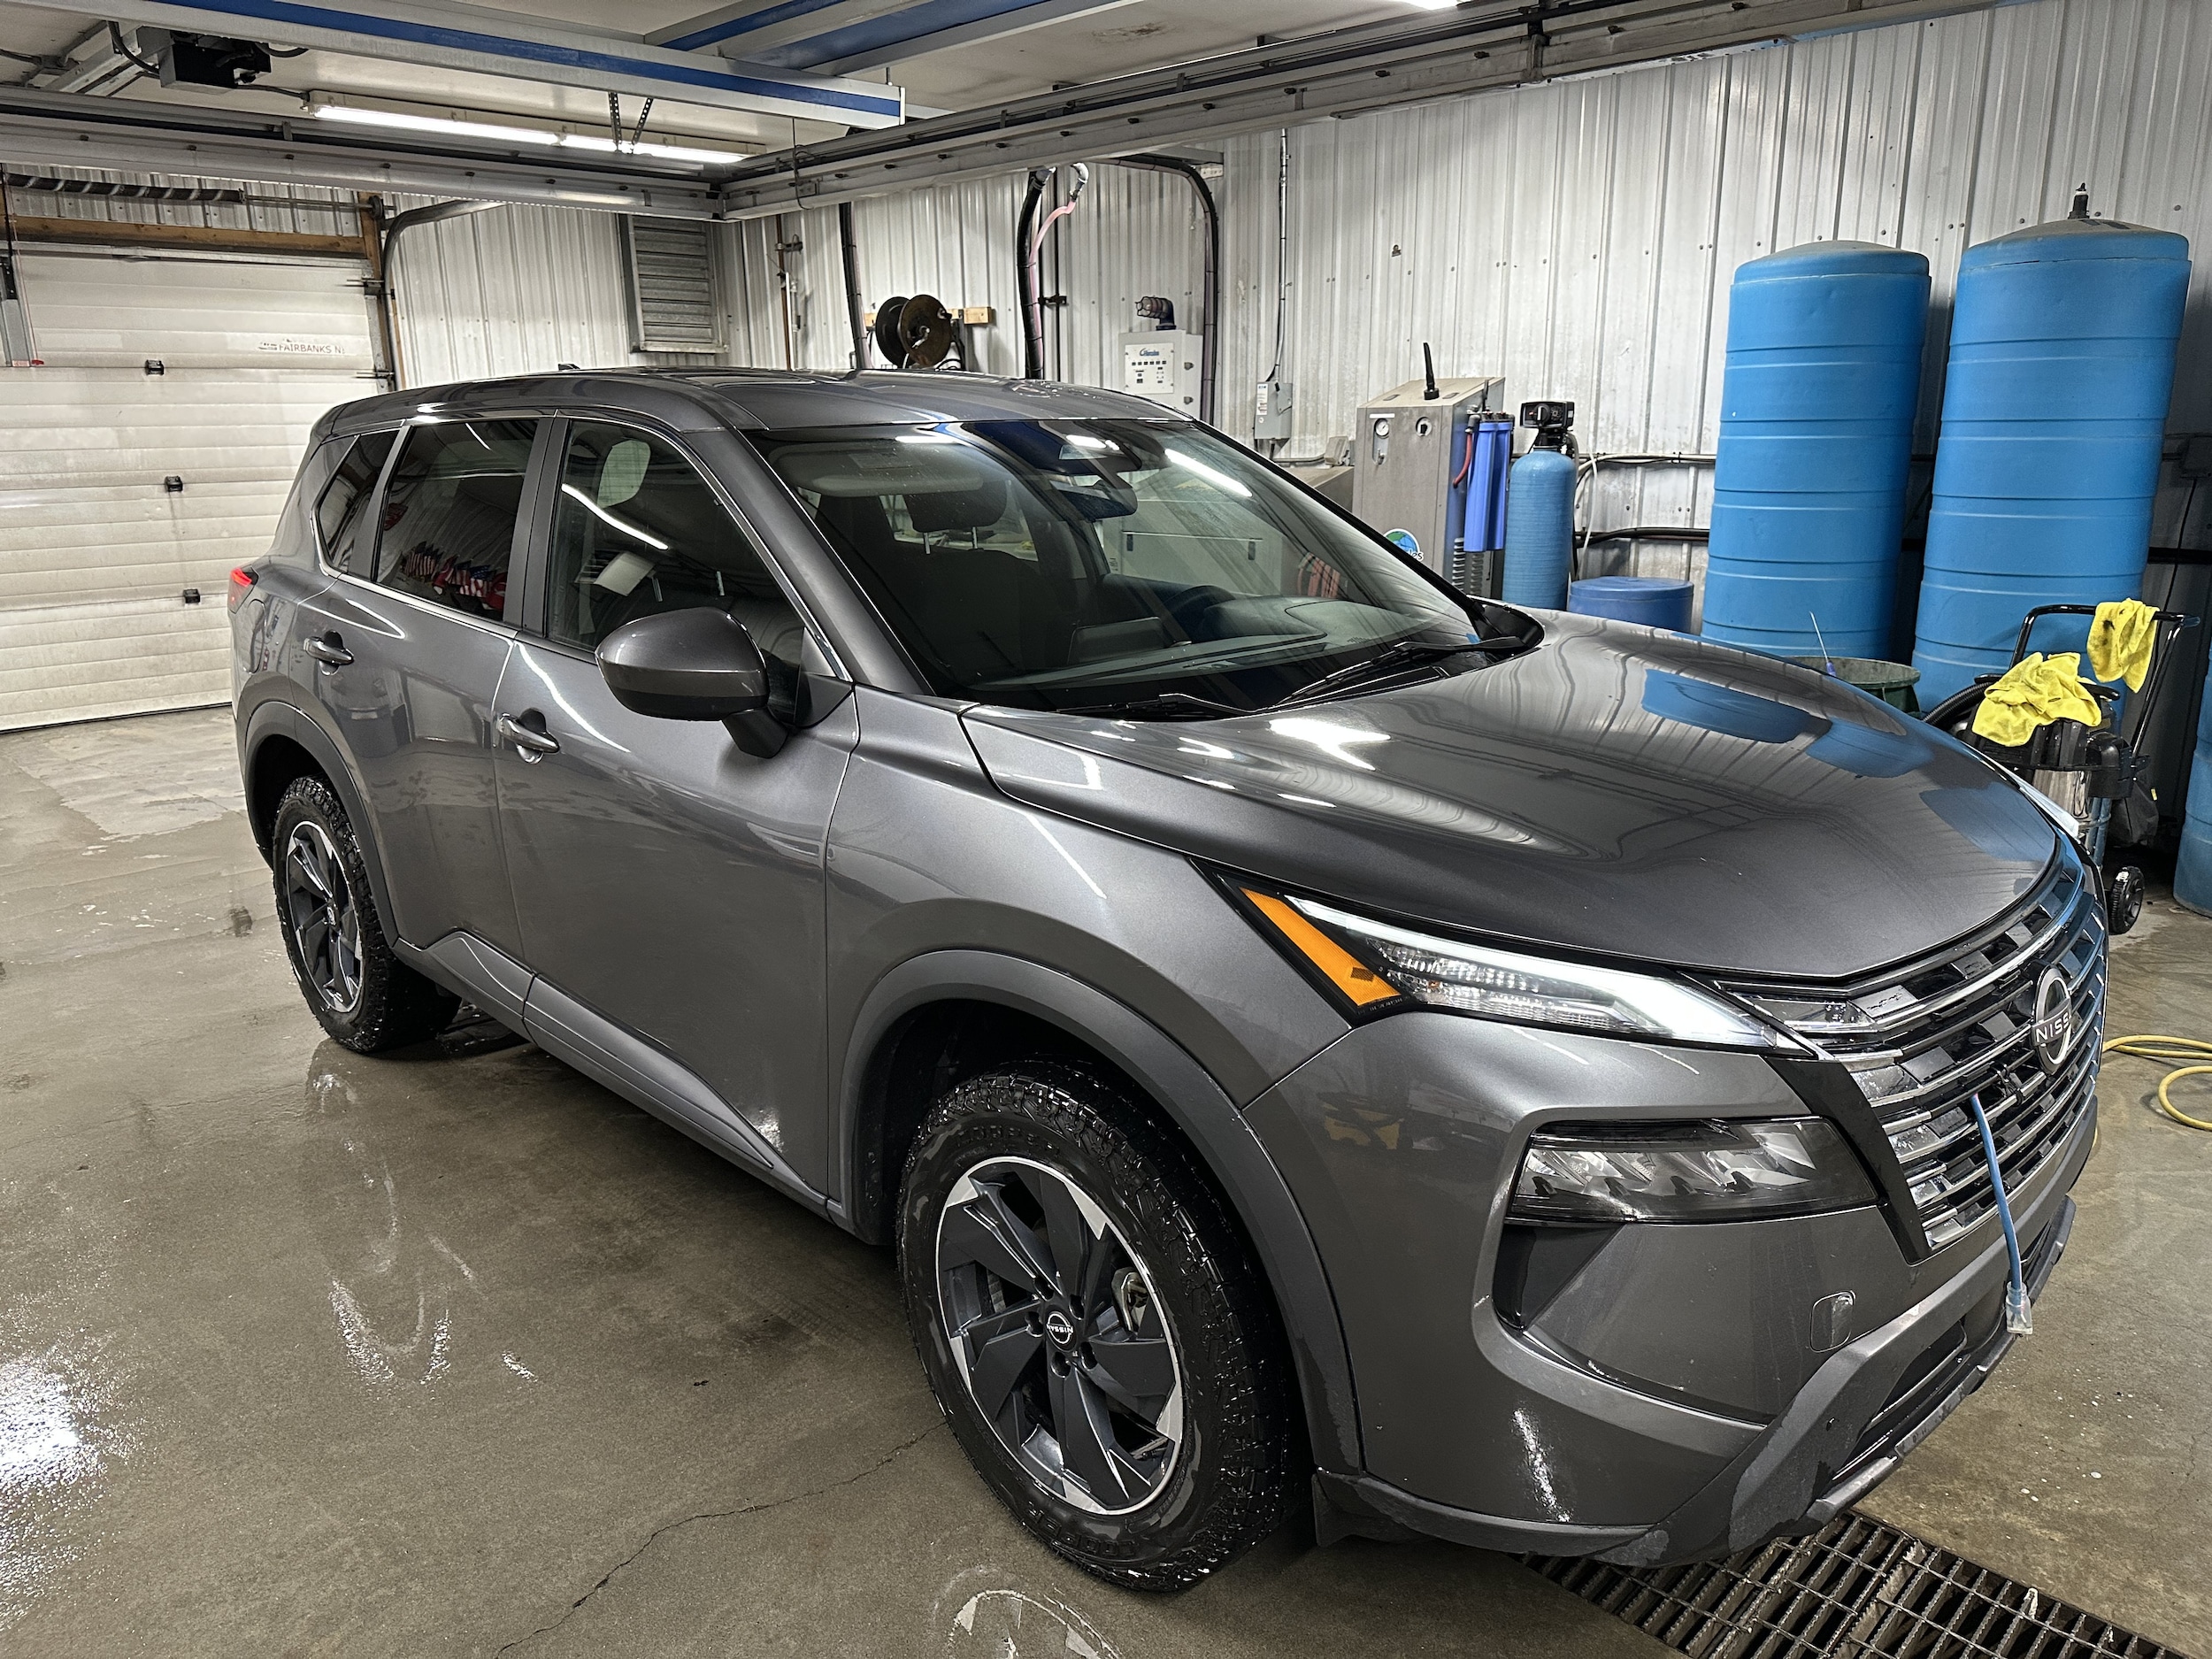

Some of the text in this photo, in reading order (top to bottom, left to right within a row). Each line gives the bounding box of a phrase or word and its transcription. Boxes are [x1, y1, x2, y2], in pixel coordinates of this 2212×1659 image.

[280, 343, 332, 354] FAIRBANKS
[2035, 1011, 2070, 1043] NISS
[1047, 1324, 1073, 1333] NISSAN
